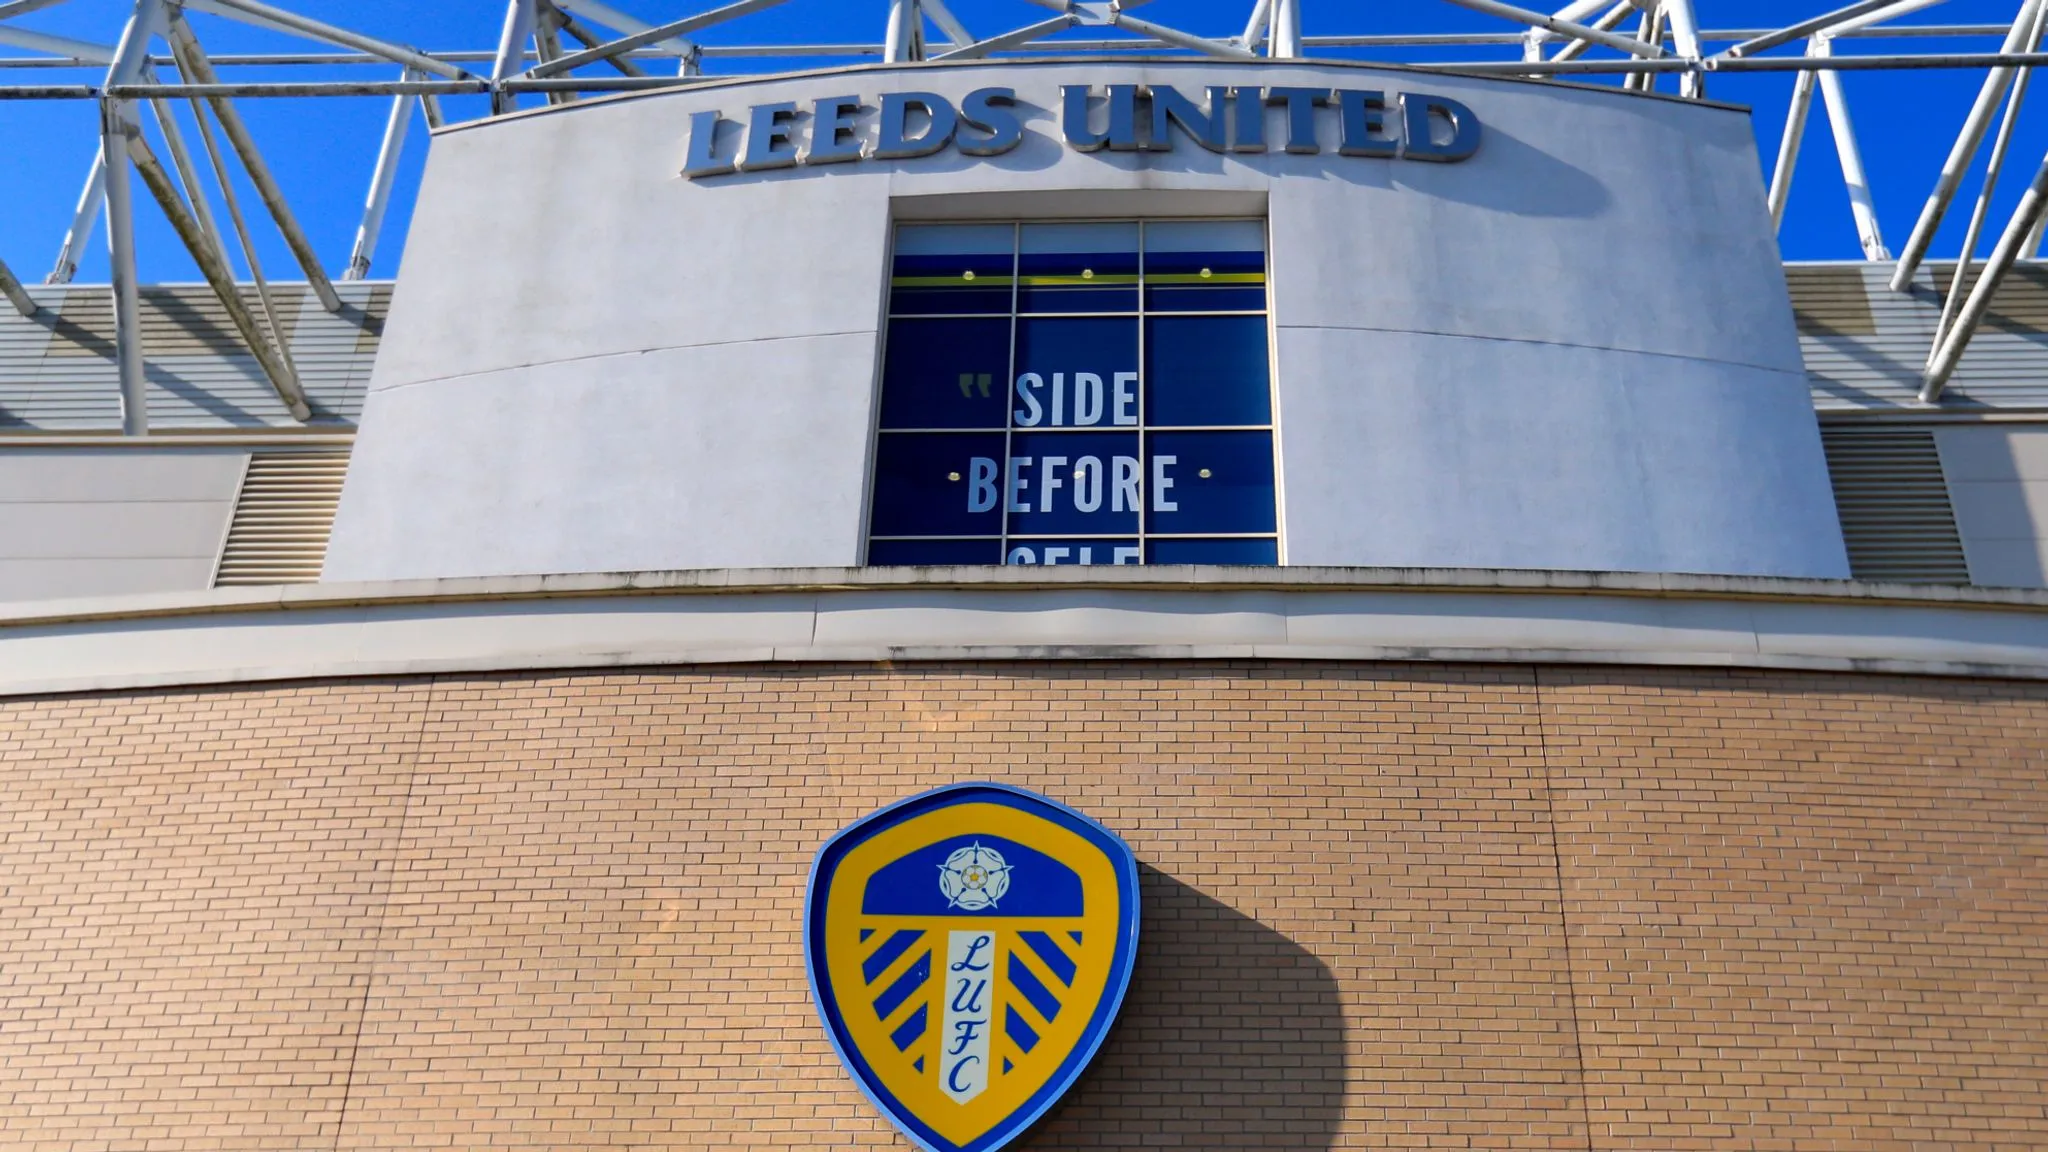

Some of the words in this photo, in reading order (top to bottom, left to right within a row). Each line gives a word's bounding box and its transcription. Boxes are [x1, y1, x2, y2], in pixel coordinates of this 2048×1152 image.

[681, 87, 1023, 180] LEEDS
[1059, 84, 1482, 163] UNITED
[967, 455, 1179, 513] BEFORE
[948, 935, 990, 1093] LUFC
